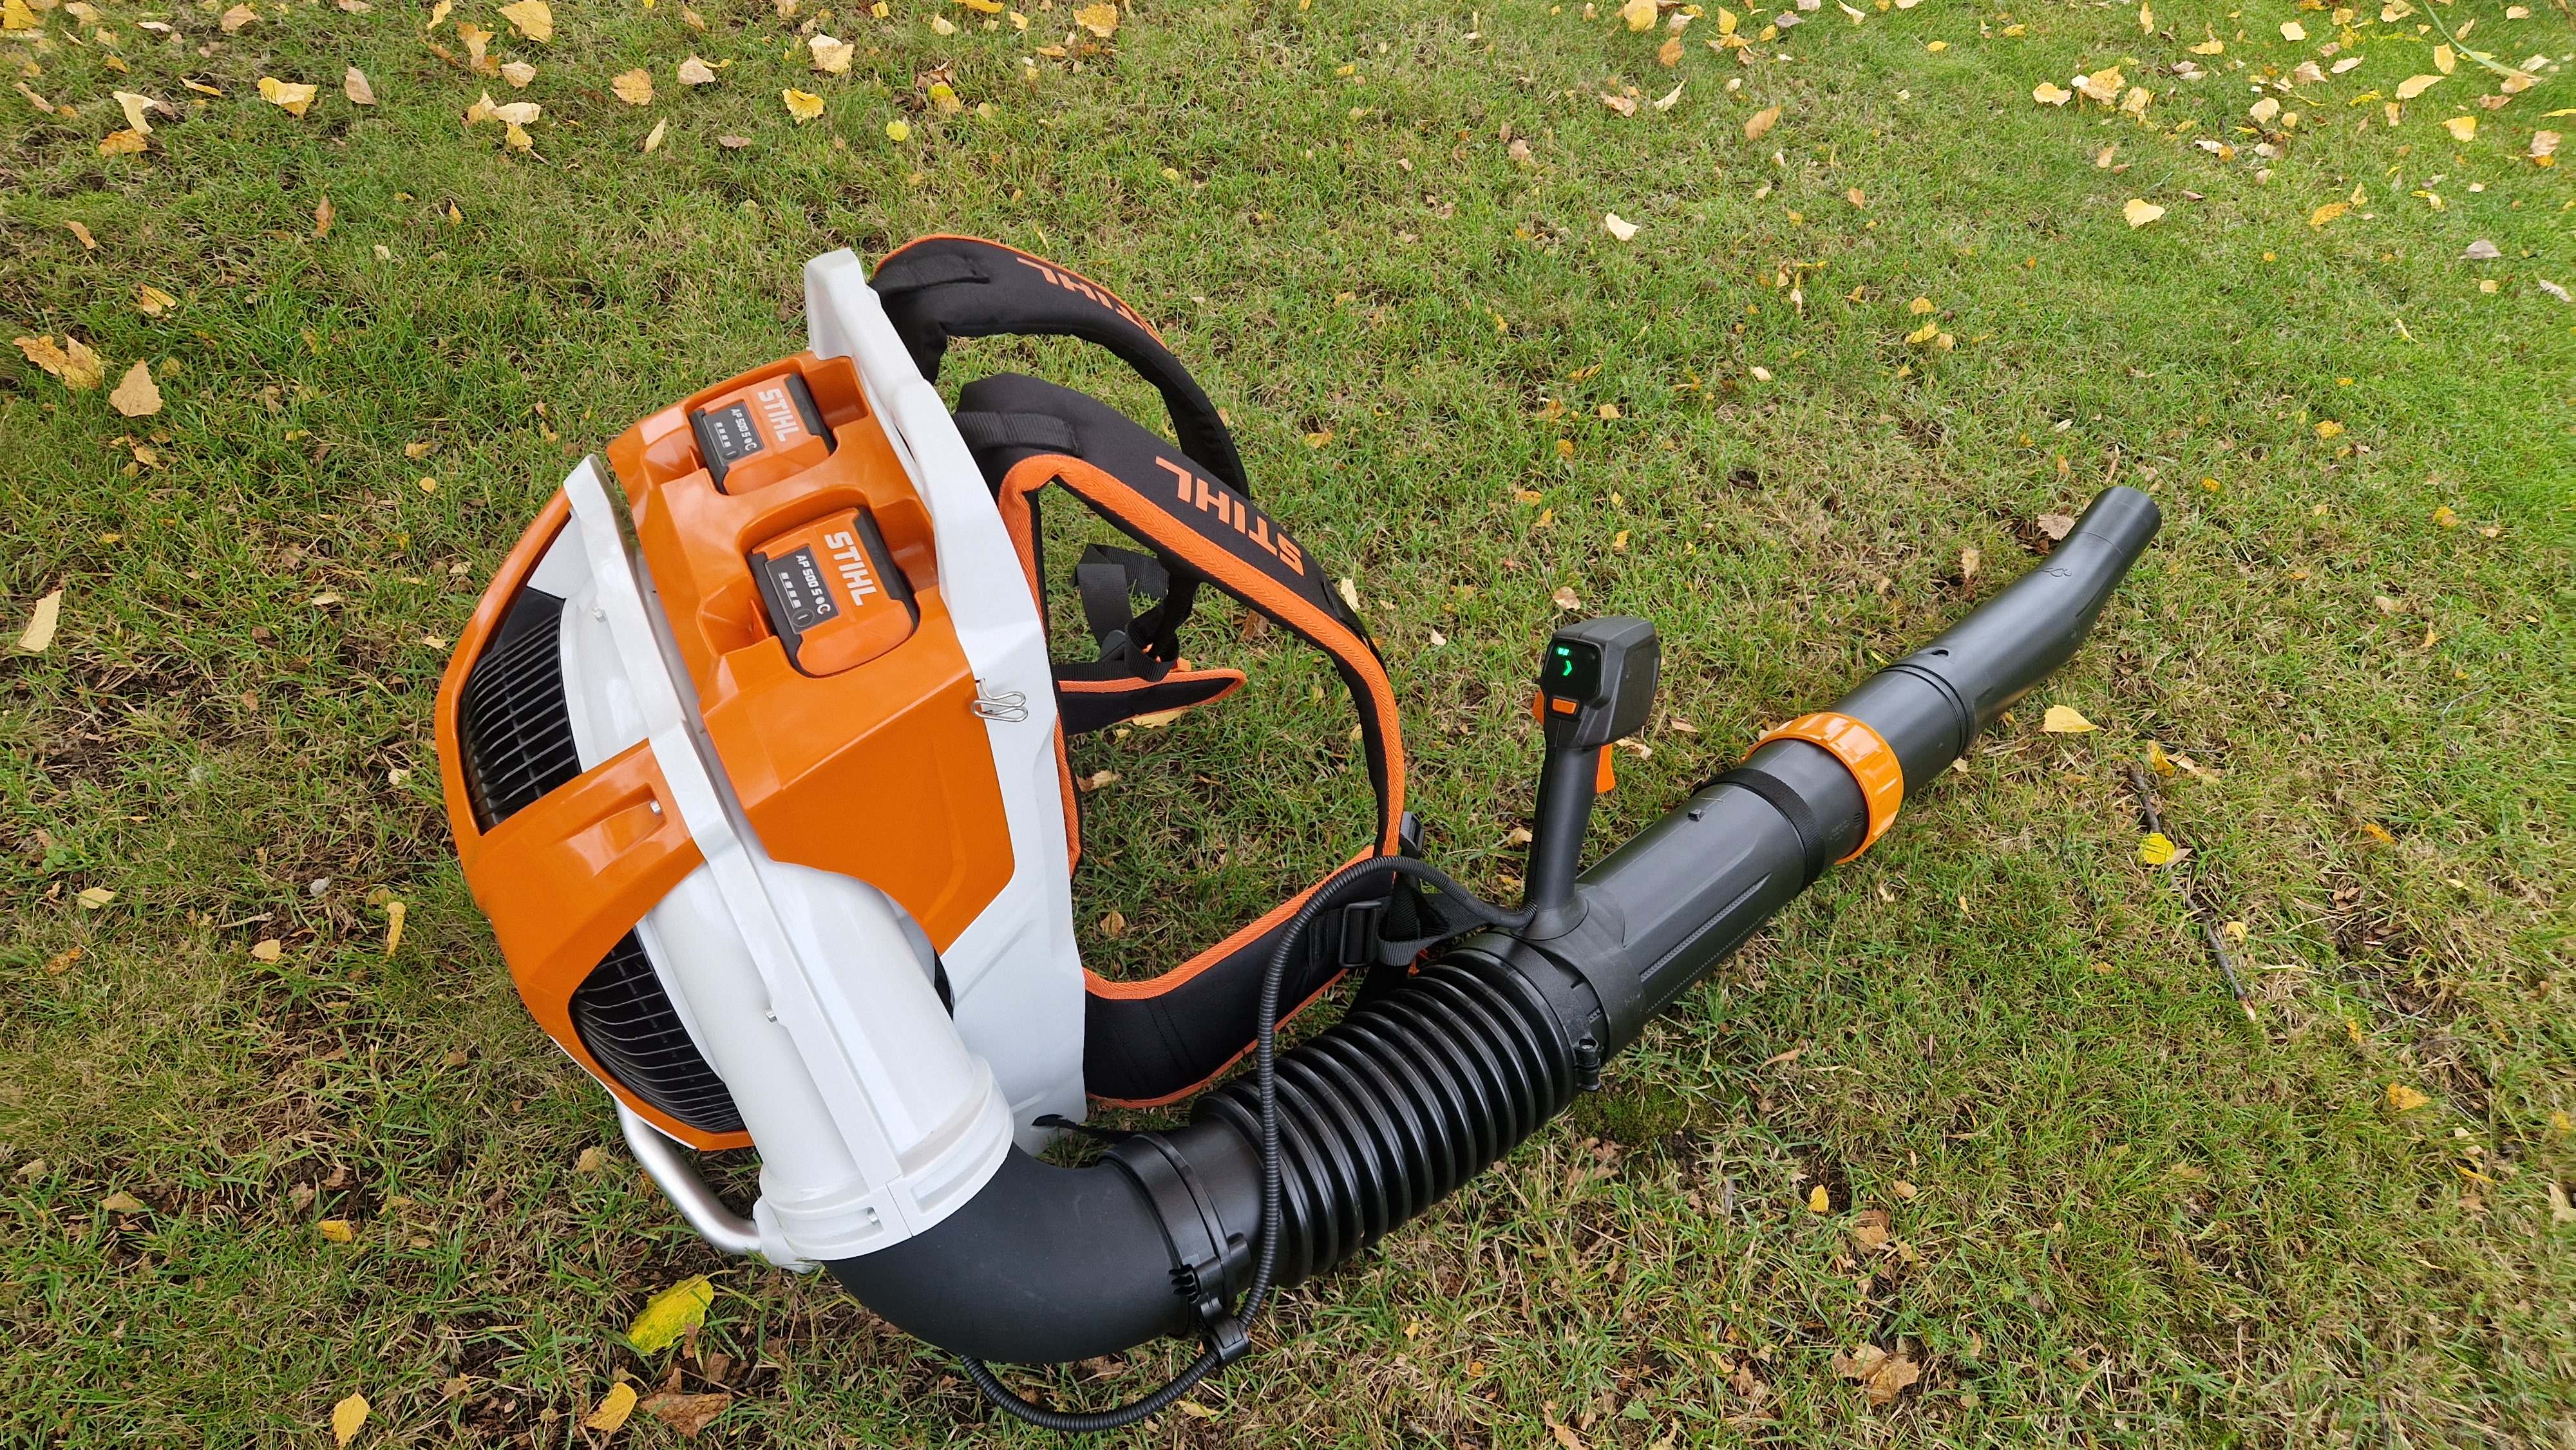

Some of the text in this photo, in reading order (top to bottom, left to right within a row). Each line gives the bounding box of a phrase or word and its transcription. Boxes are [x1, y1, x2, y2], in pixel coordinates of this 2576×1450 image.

[1016, 257, 1169, 351] TIHL
[730, 409, 743, 418] AP
[758, 388, 799, 442] STIHL
[735, 417, 749, 432] 500
[1155, 455, 1304, 577] STIHL
[795, 555, 810, 567] AP
[824, 531, 877, 607] STIHL
[802, 569, 819, 588] 500
[810, 588, 823, 596] S
